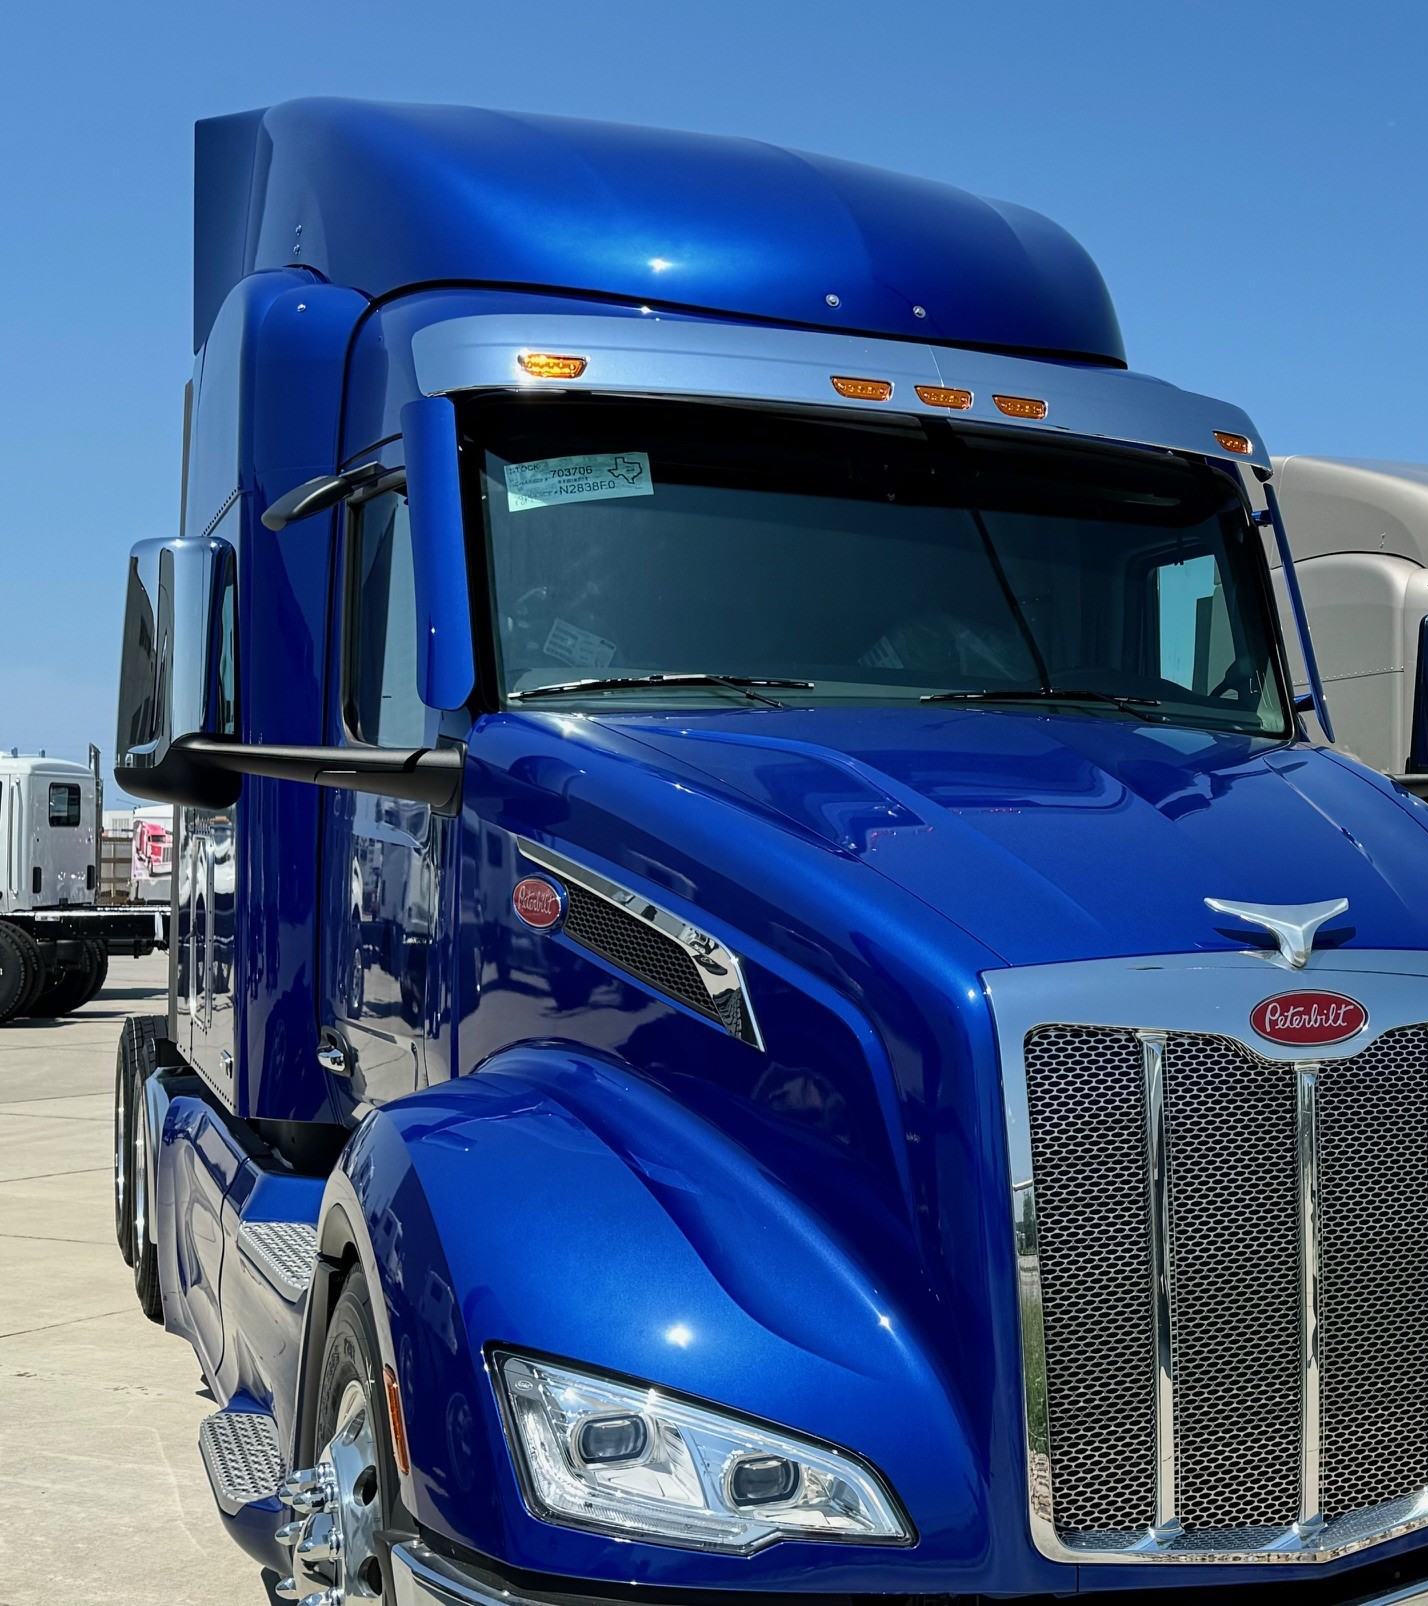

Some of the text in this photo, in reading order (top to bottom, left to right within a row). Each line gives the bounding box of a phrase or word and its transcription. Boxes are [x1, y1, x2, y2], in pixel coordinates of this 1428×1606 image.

[550, 466, 593, 479] 703706
[518, 886, 555, 914] Peterbilt
[1265, 1003, 1354, 1032] Peterbilt
